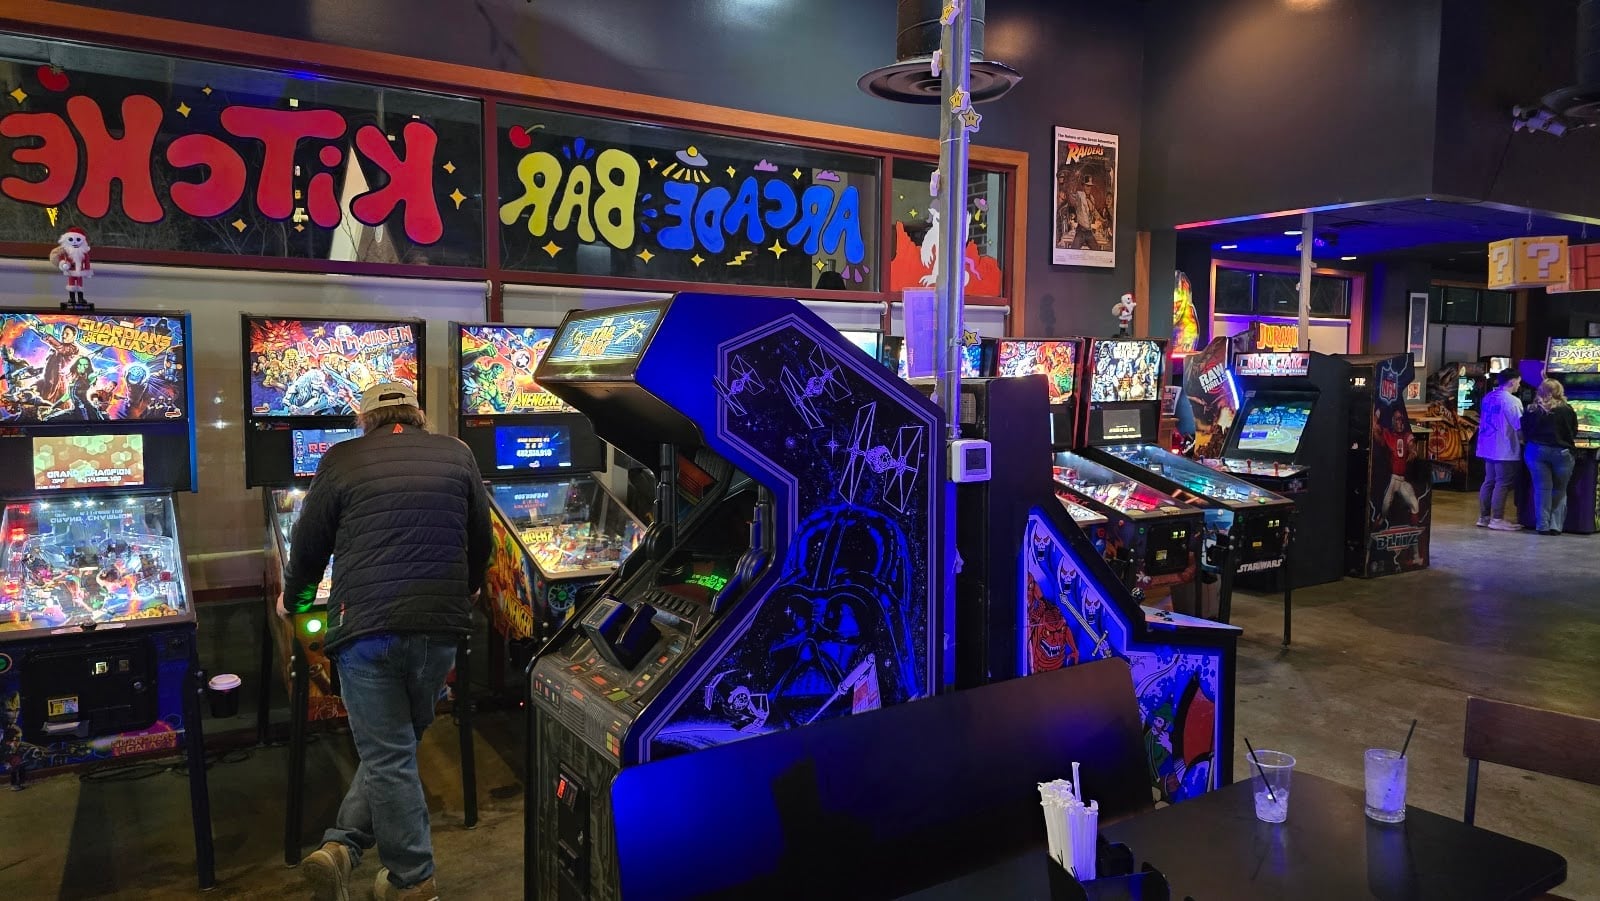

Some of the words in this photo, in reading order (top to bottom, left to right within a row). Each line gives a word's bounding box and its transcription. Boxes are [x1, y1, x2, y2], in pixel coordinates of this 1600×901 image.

[1065, 142, 1104, 165] RAIDERS
[77, 318, 173, 347] GUARDIANS
[297, 337, 345, 358] IRON
[344, 325, 414, 351] MAIDEN
[97, 333, 169, 356] GALAXY
[1246, 354, 1270, 369] NBA
[1276, 353, 1303, 369] JAM
[1199, 363, 1225, 387] RAW
[505, 386, 564, 412] AVENGERS
[46, 469, 80, 479] GRAND
[85, 467, 132, 477] CHAMPION
[1376, 531, 1420, 550] BLITZ
[1236, 562, 1259, 573] STAR
[1259, 558, 1283, 570] WARS
